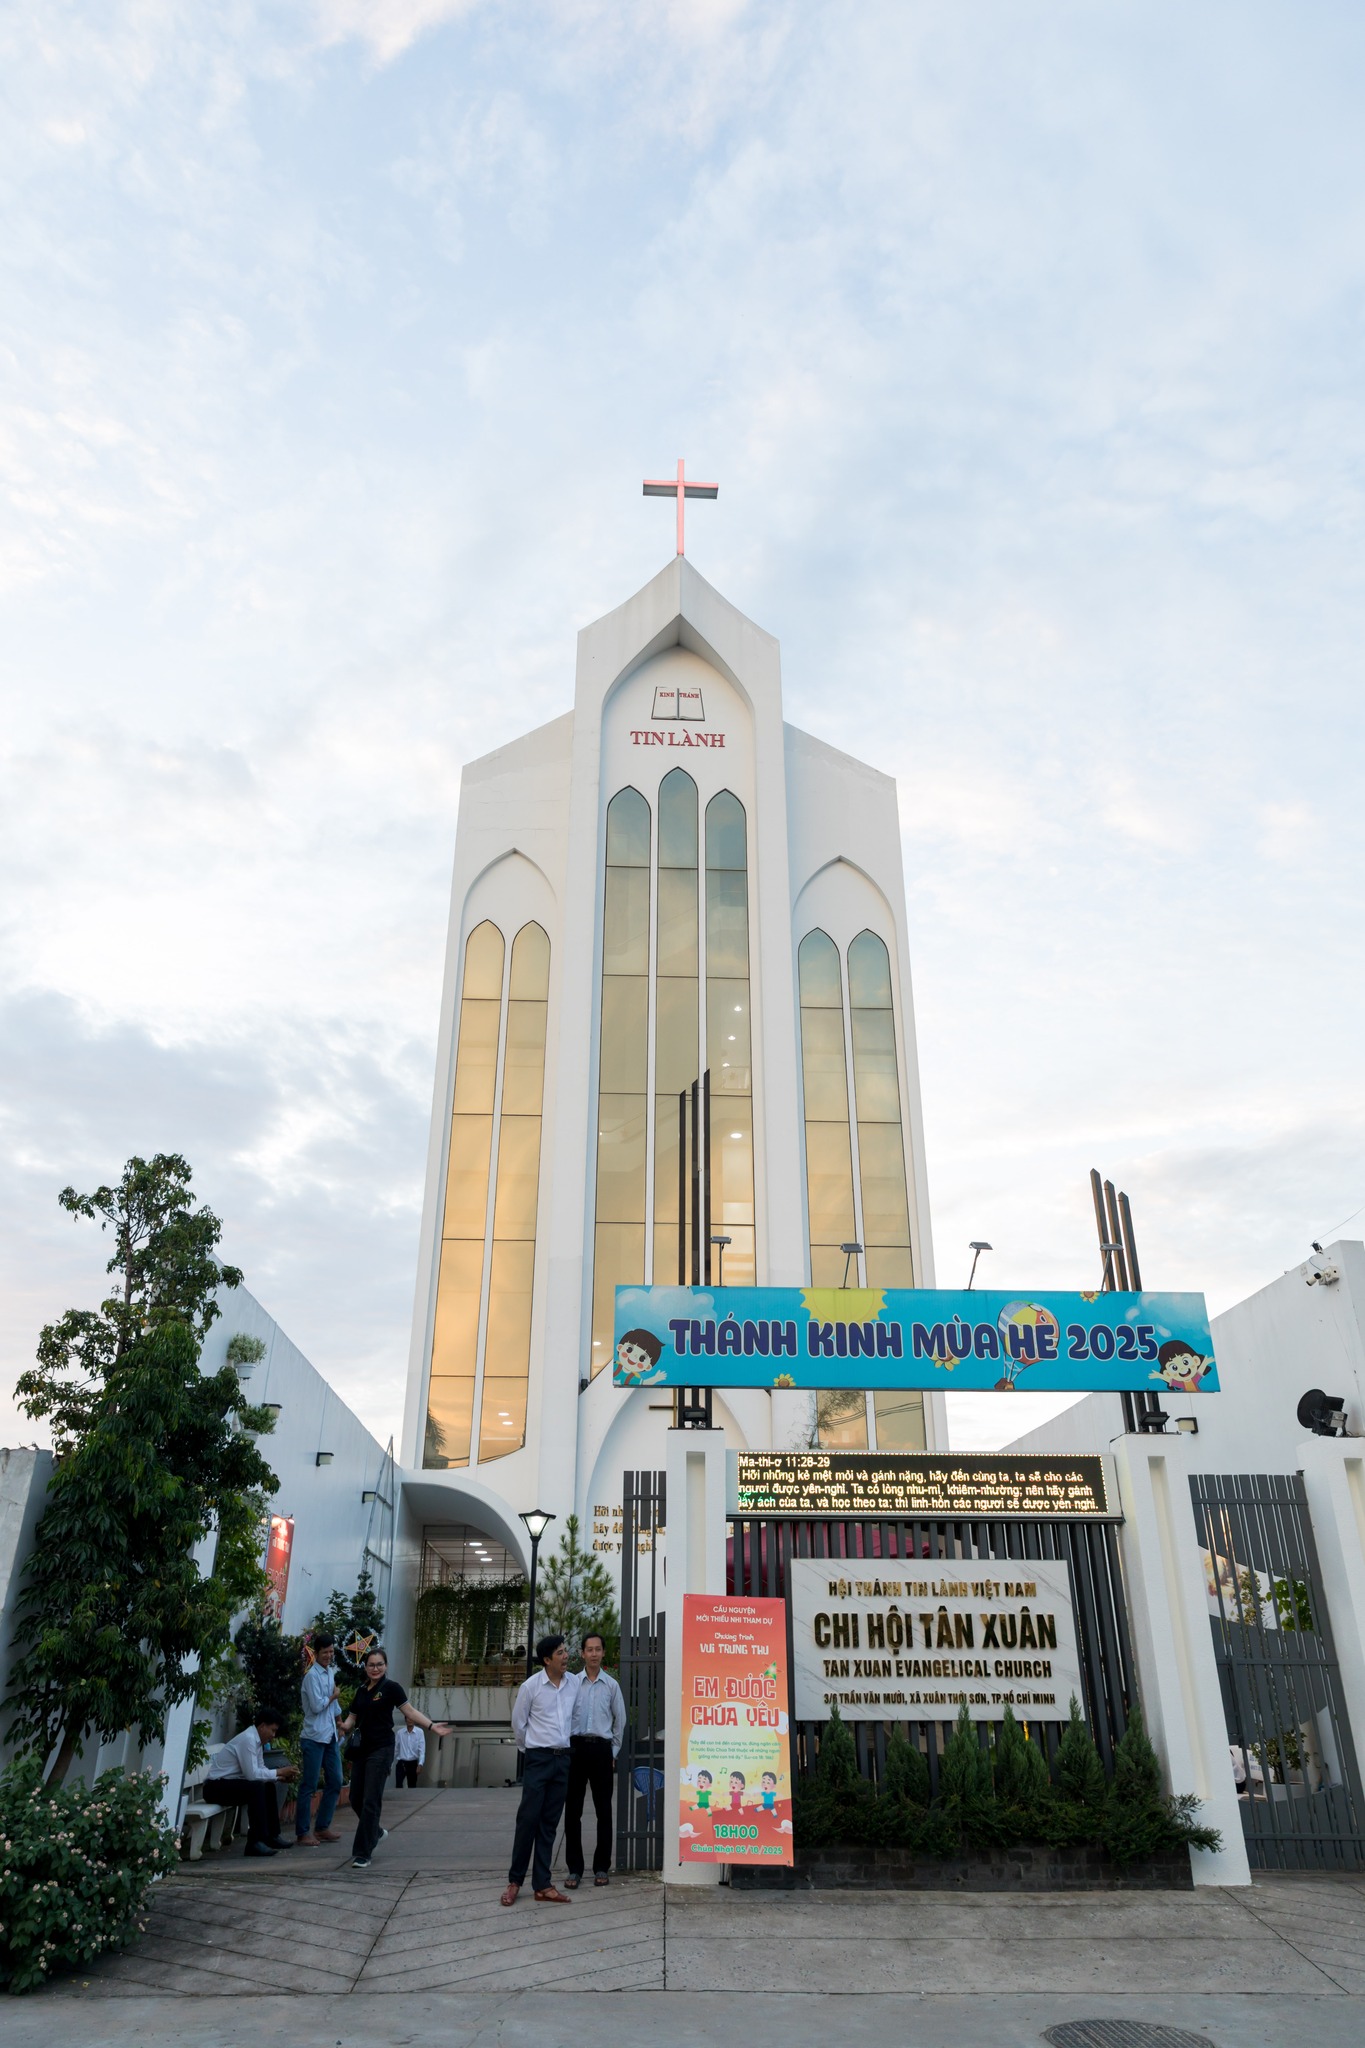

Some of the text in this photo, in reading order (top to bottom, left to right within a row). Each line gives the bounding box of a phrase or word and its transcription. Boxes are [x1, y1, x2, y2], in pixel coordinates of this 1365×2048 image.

[630, 729, 725, 747] TIN LÀNH
[668, 1311, 1160, 1361] THÁNH KINH MÙA HÈ 2025
[740, 1456, 830, 1467] Ma-thi-ơ 11:28-29
[742, 1469, 760, 1480] Hỡi
[763, 1469, 795, 1483] những
[797, 1469, 810, 1480] kẻ
[813, 1470, 832, 1482] mệt
[856, 1470, 868, 1480] và
[871, 1470, 896, 1483] gánh
[929, 1470, 948, 1484] hãy
[950, 1468, 970, 1481] đến
[972, 1471, 996, 1484] cùng
[1015, 1471, 1026, 1482] ta
[1028, 1471, 1041, 1482] sẽ
[1043, 1471, 1062, 1482] cho
[1065, 1471, 1083, 1482] các
[851, 1483, 864, 1494] Ta
[867, 1483, 879, 1494] có
[882, 1483, 904, 1496] lòng
[1025, 1485, 1044, 1496] nên
[1046, 1485, 1065, 1498] hãy
[757, 1497, 776, 1507] ách
[779, 1497, 797, 1507] của
[816, 1497, 829, 1507] và
[832, 1497, 850, 1508] học
[853, 1497, 876, 1508] theo
[895, 1497, 909, 1508] thì
[953, 1498, 971, 1509] các
[1007, 1498, 1020, 1509] sẽ
[593, 1521, 609, 1537] hãy
[592, 1539, 613, 1553] được
[829, 1578, 1037, 1600] HỘI THÁNH TIN LÀNH VIỆT NAM
[814, 1605, 1057, 1656] CHI HỘI TÂN XUÂN
[718, 1643, 748, 1655] TRUNG
[751, 1645, 769, 1655] THU
[823, 1659, 1053, 1678] TAN XUAN EVANGELICAL CHURCH
[693, 1673, 777, 1702] EM ĐƯỢC
[923, 1690, 946, 1705] XUÂN
[1033, 1692, 1056, 1705] MINH
[690, 1700, 780, 1727] CHÚA YÊU
[713, 1824, 759, 1839] 18H00
